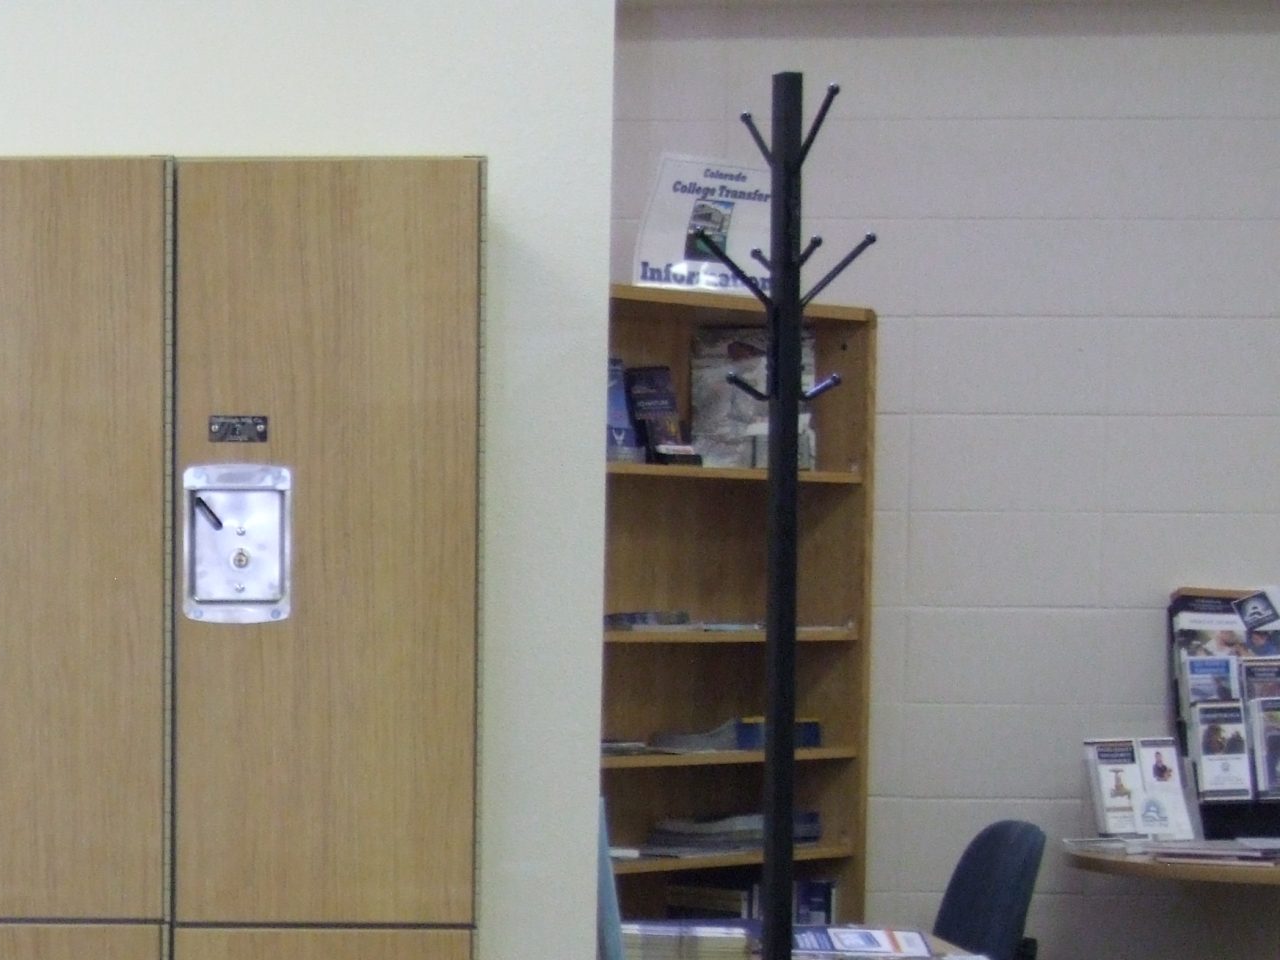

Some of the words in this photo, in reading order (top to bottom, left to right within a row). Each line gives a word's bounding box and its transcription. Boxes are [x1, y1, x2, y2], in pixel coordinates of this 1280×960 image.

[703, 168, 747, 182] Colorado
[672, 181, 716, 200] College
[718, 185, 771, 202] Transfer
[640, 261, 772, 291] Inforaton
